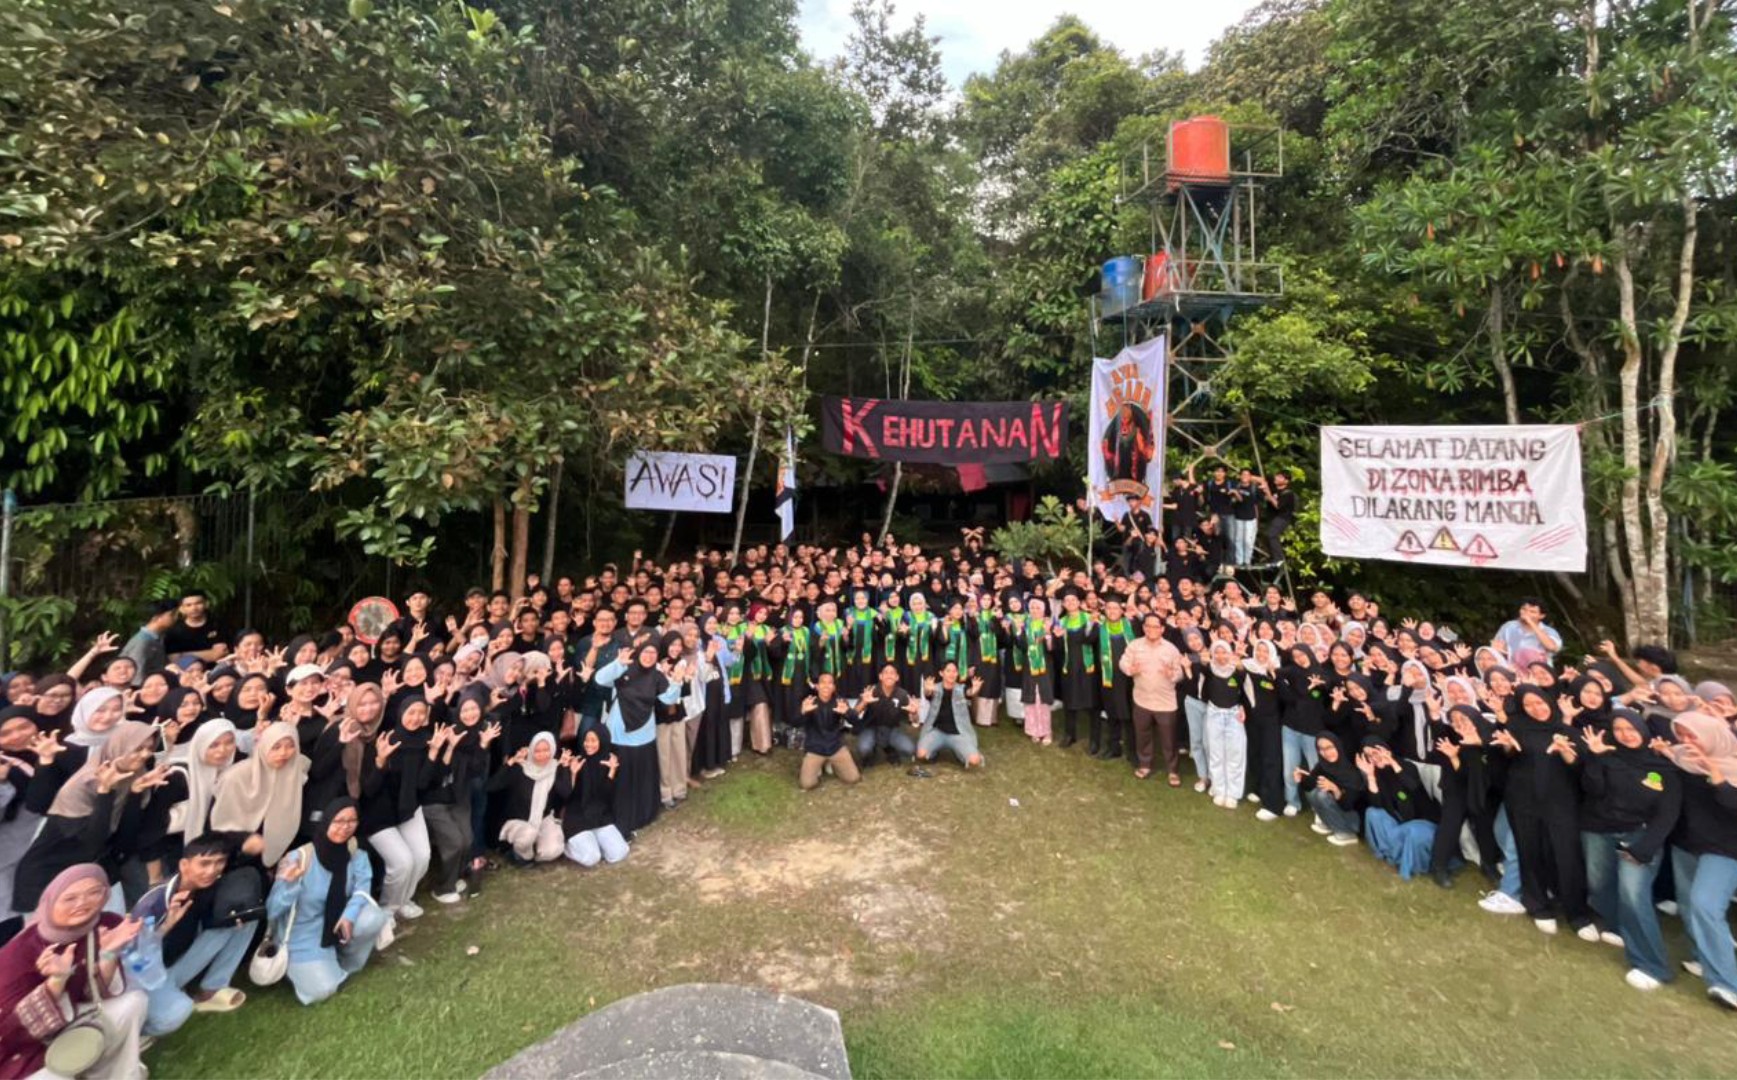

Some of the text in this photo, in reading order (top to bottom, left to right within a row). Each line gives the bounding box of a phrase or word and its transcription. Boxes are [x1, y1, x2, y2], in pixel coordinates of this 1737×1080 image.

[840, 397, 1062, 459] KEHUTANAN
[1338, 437, 1547, 462] SELAMAT DATANG
[629, 461, 727, 500] AWAS!
[1459, 468, 1533, 494] RIMBA
[1351, 496, 1545, 525] DILARANG MANJA
